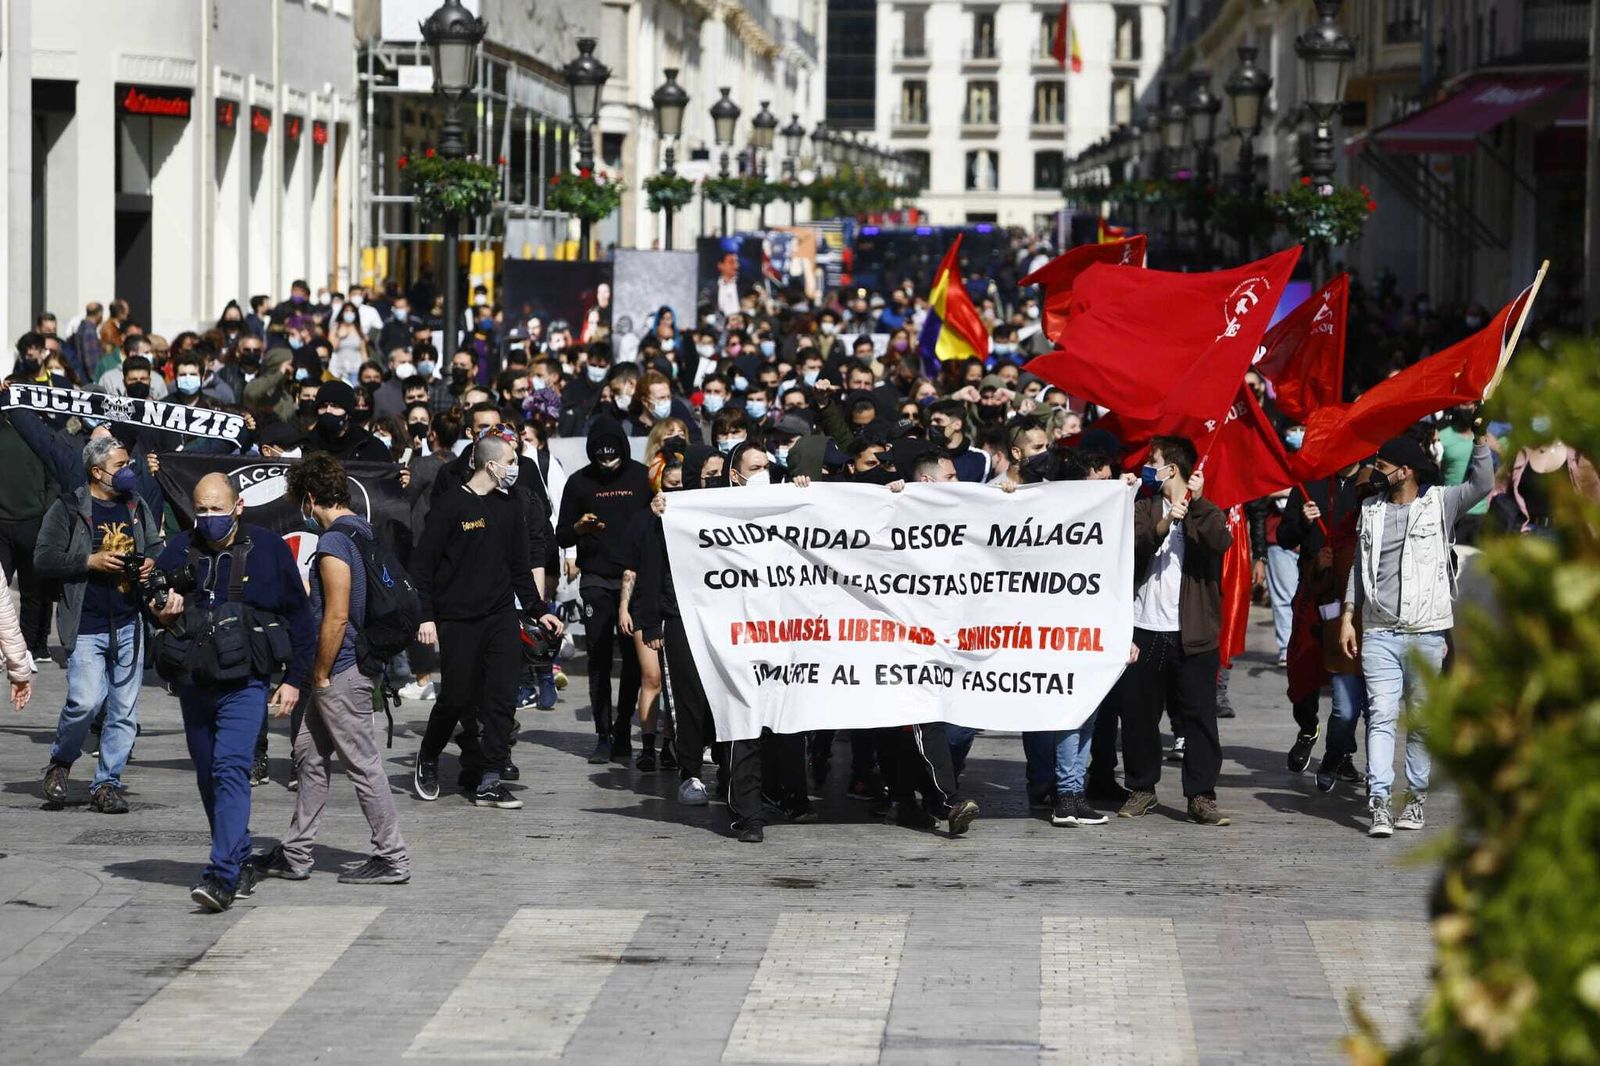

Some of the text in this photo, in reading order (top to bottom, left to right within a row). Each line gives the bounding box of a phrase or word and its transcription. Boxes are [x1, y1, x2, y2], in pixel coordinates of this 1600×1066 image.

[9, 387, 93, 414] FUCK
[142, 402, 244, 438] NAZIS
[699, 517, 1104, 550] SOLIDARIDAD DESDE MÁLAGA
[704, 568, 759, 590] CON
[767, 565, 795, 588] LOS
[970, 571, 1101, 595] DETENIDOS
[1038, 626, 1105, 652] TOTAL
[831, 664, 860, 685] AL
[875, 664, 954, 688] ESTADO
[962, 671, 1075, 695] FASCISTA!
